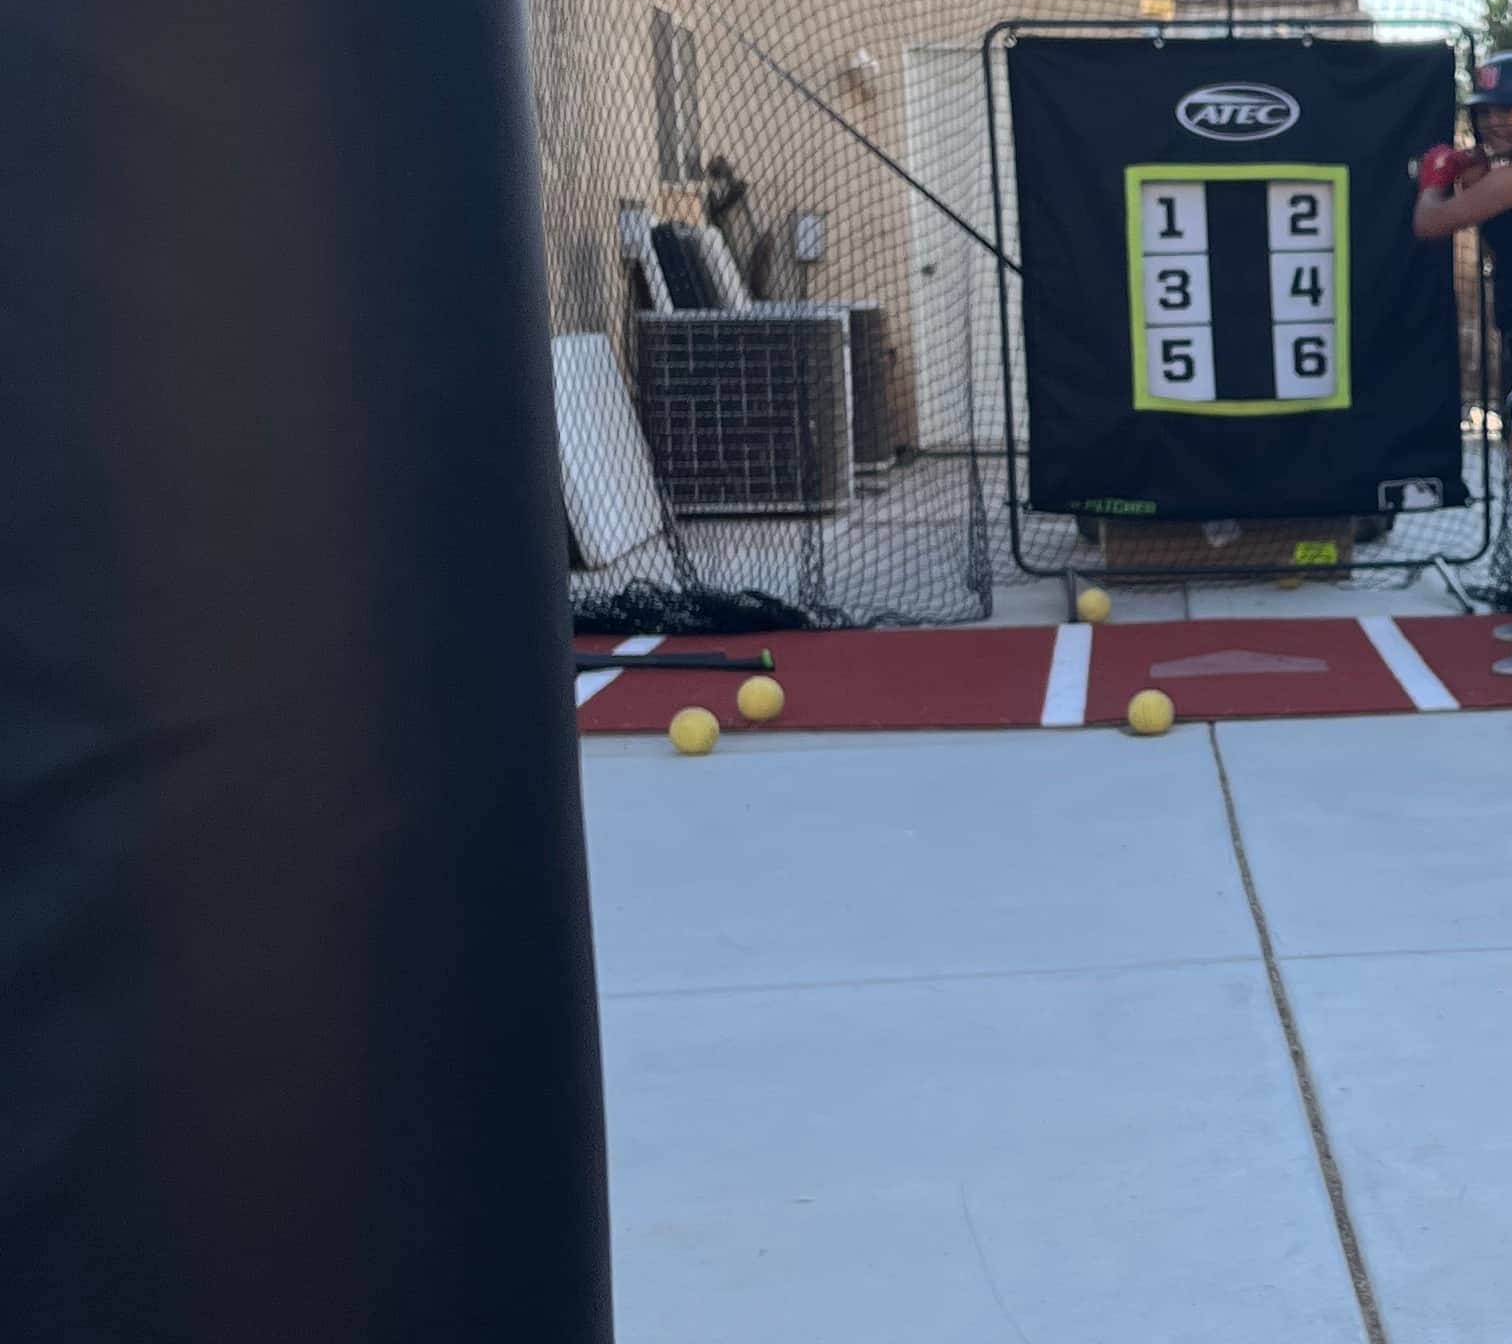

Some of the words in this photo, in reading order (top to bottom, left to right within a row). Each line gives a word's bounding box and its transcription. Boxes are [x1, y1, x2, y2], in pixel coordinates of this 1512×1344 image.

[1190, 103, 1288, 126] ATEC
[1157, 197, 1184, 239] 1
[1288, 194, 1319, 237] 2
[1157, 269, 1191, 311] 3
[1289, 265, 1324, 307] 4
[1161, 339, 1195, 384] 5
[1292, 336, 1328, 378] 6
